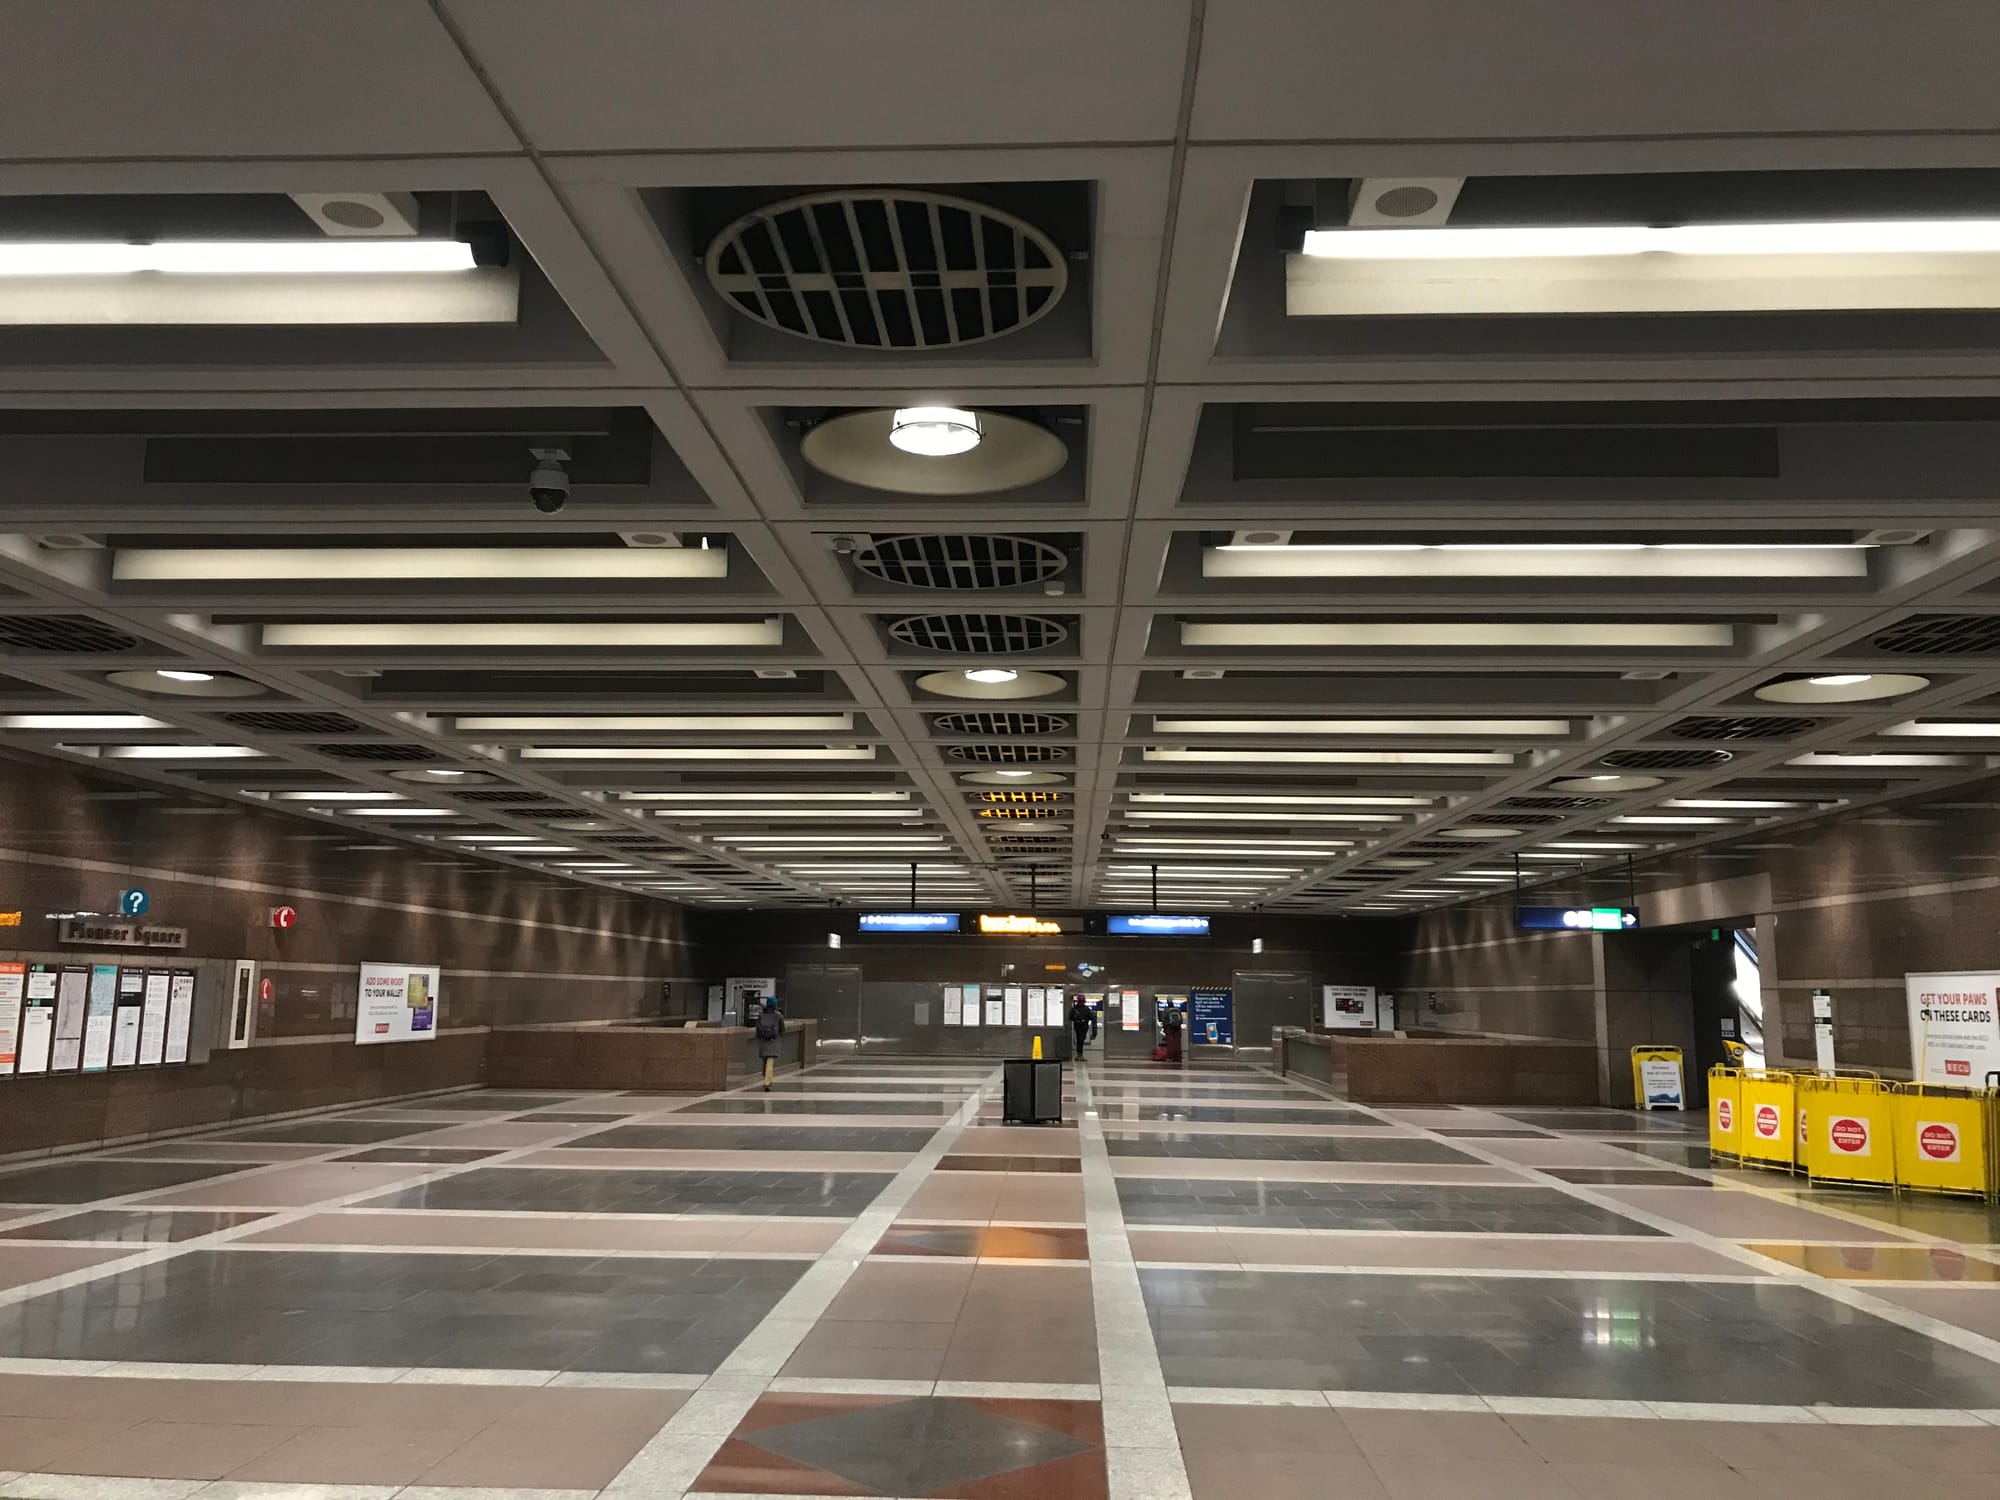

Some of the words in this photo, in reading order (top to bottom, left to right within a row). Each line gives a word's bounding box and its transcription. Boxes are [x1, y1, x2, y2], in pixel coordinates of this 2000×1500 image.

[69, 921, 129, 941] Pioneer
[134, 925, 182, 945] Square
[366, 977, 376, 985] ADD
[377, 977, 390, 985] SOME
[364, 989, 372, 997] TO
[373, 989, 386, 997] YOUR
[386, 989, 404, 997] WALLET
[1920, 993, 1936, 1005] GET
[1937, 993, 1961, 1006] YOUR
[1963, 993, 1987, 1006] PAWS
[1934, 1010, 1960, 1022] THESE
[1961, 1010, 1991, 1023] CARDS
